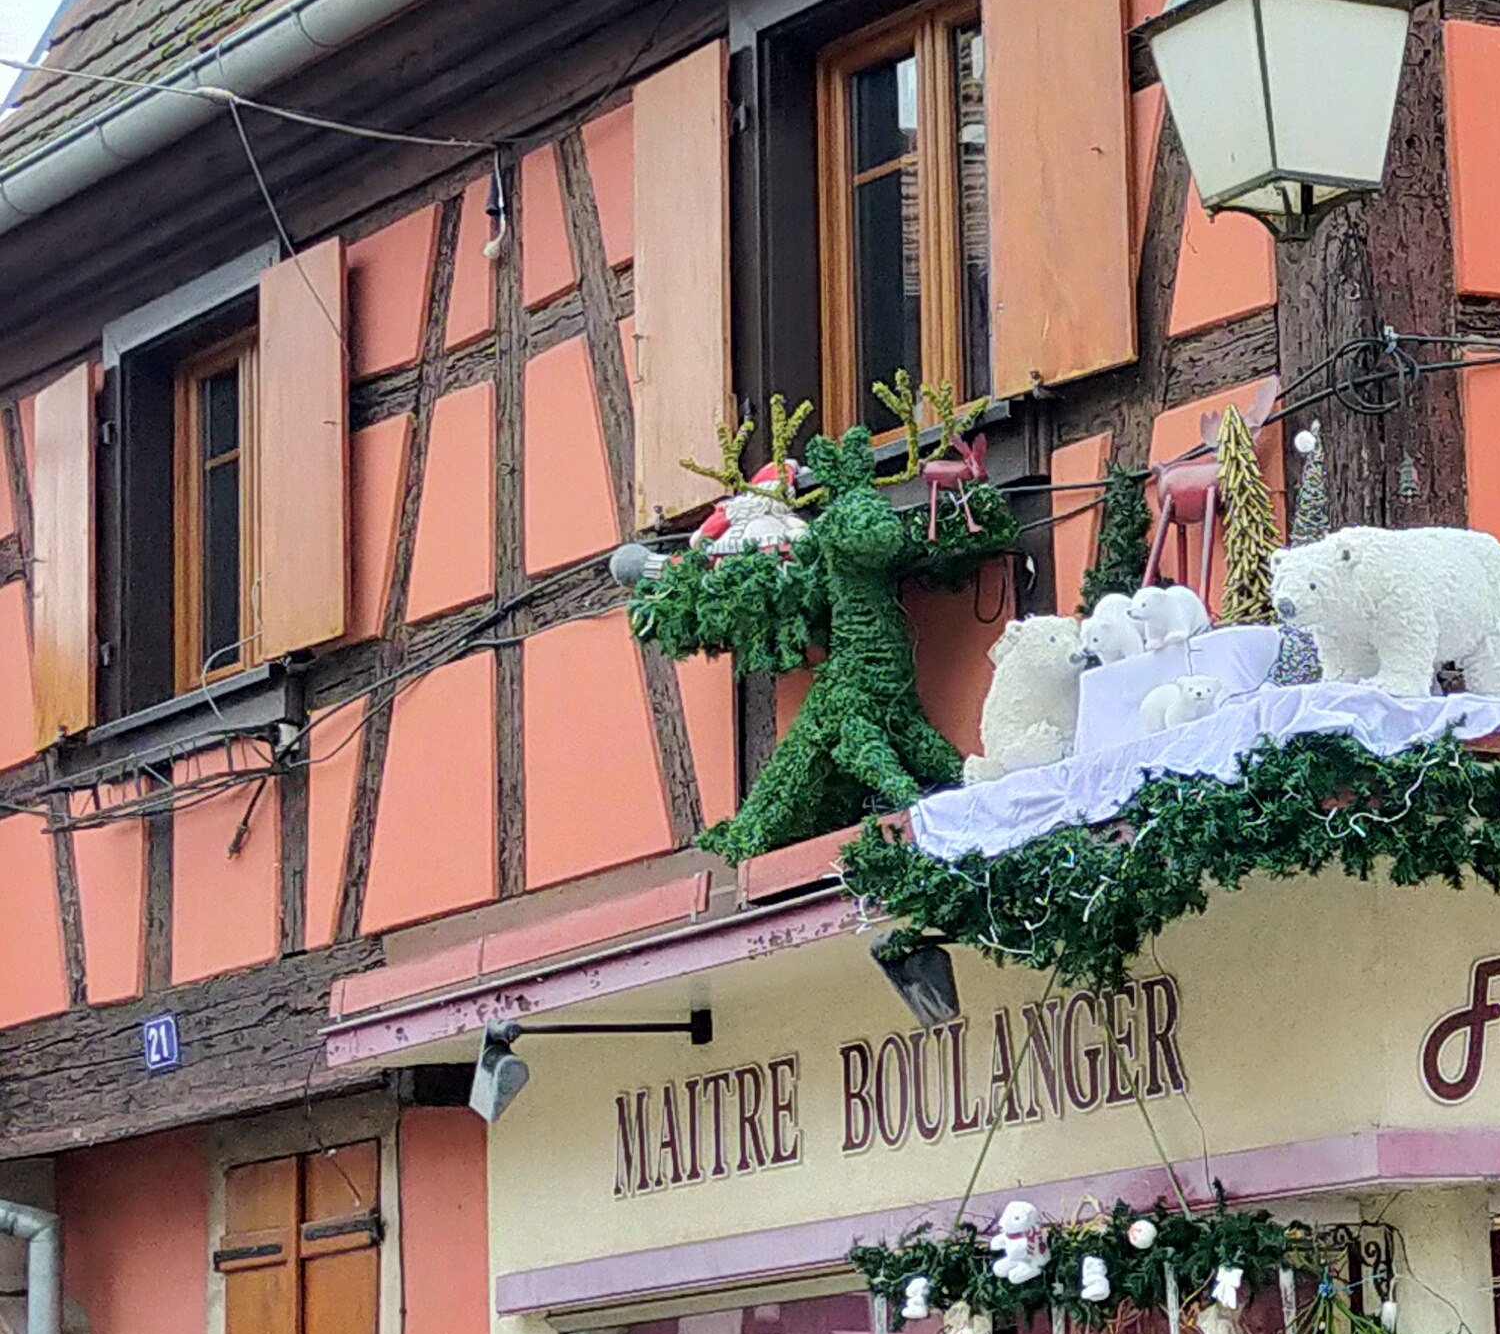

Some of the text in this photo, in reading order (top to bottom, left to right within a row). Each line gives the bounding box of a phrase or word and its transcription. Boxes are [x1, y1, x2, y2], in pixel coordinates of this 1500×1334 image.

[148, 1024, 169, 1062] 21
[611, 973, 1190, 1198] MAITRE BOULANGER
